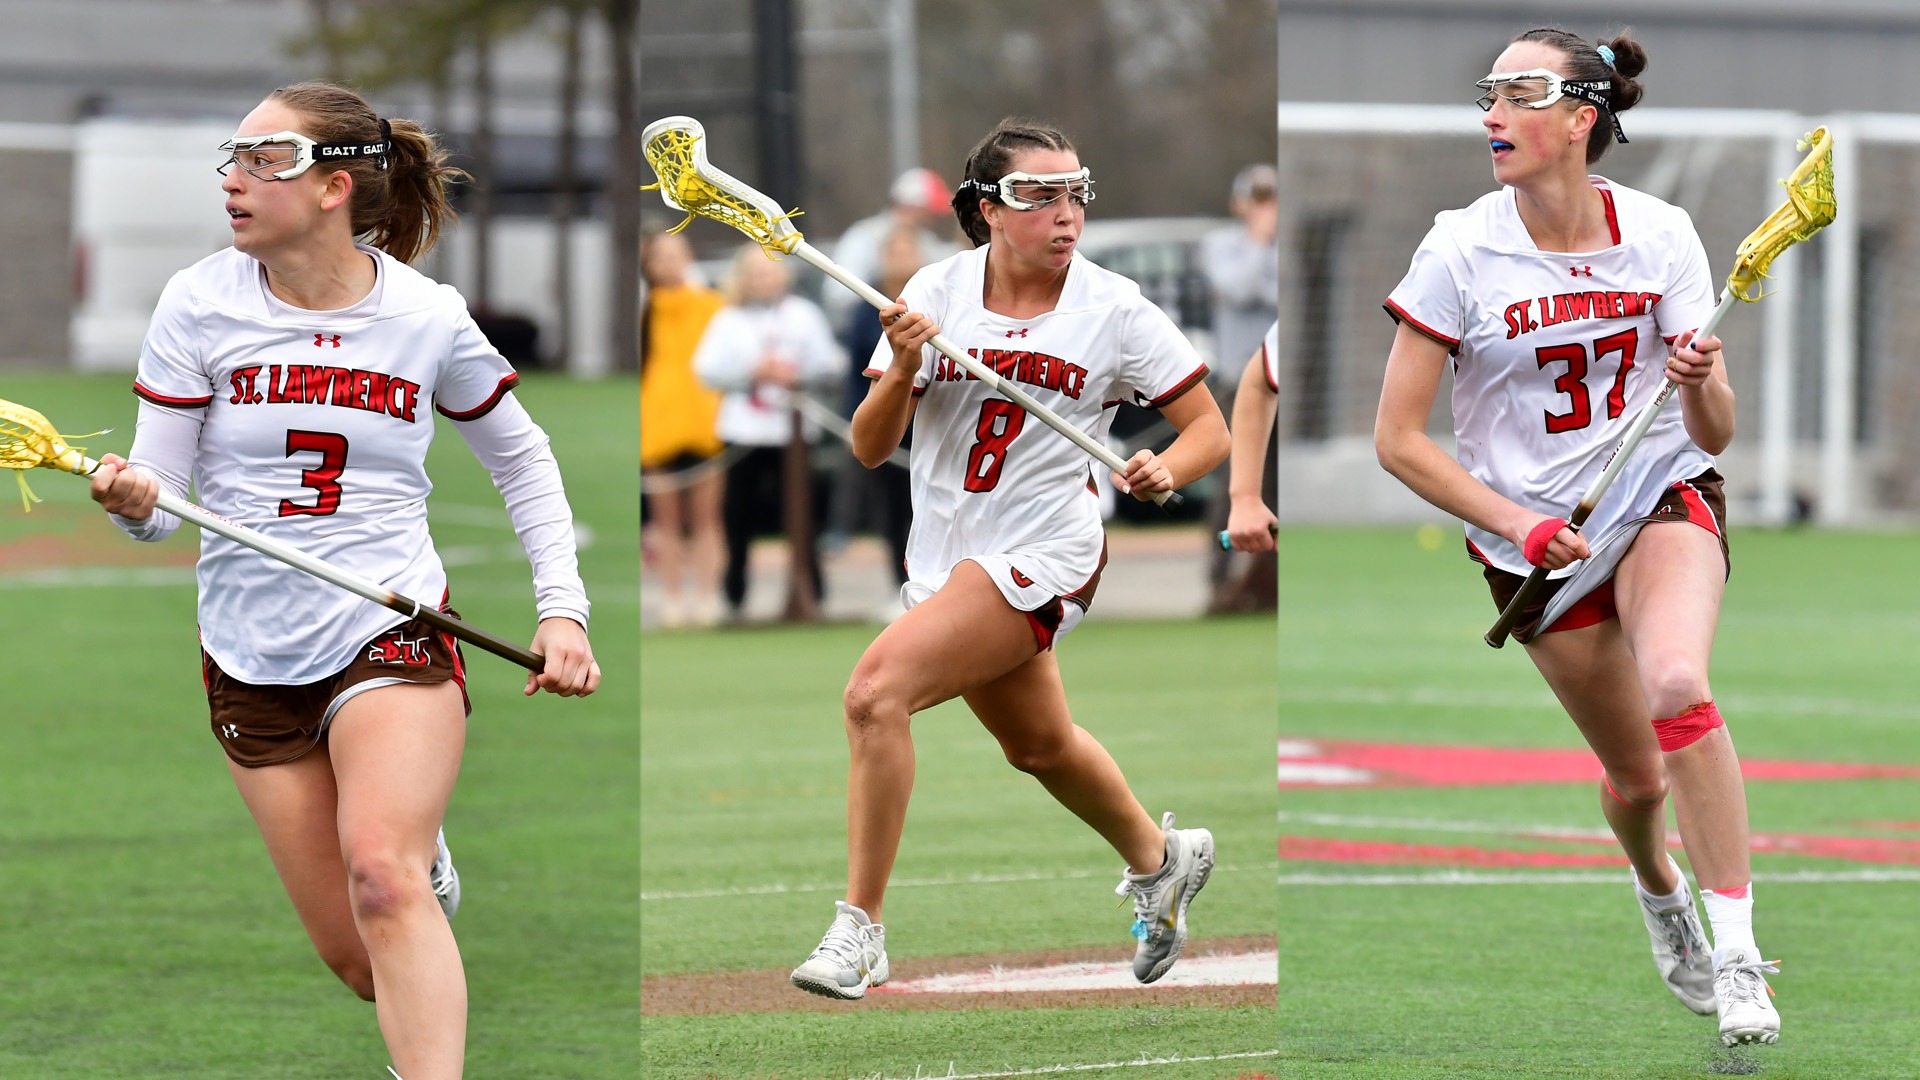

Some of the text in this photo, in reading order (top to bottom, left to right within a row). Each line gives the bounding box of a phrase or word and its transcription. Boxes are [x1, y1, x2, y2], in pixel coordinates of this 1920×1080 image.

[1588, 92, 1606, 105] GAIT
[322, 143, 384, 156] GAIT GAIT
[981, 183, 998, 193] GAIT
[1504, 299, 1538, 340] ST.
[229, 364, 422, 424] ST. LAWRENCE
[1535, 327, 1639, 434] 37
[963, 397, 1027, 493] 8
[278, 428, 349, 518] 3
